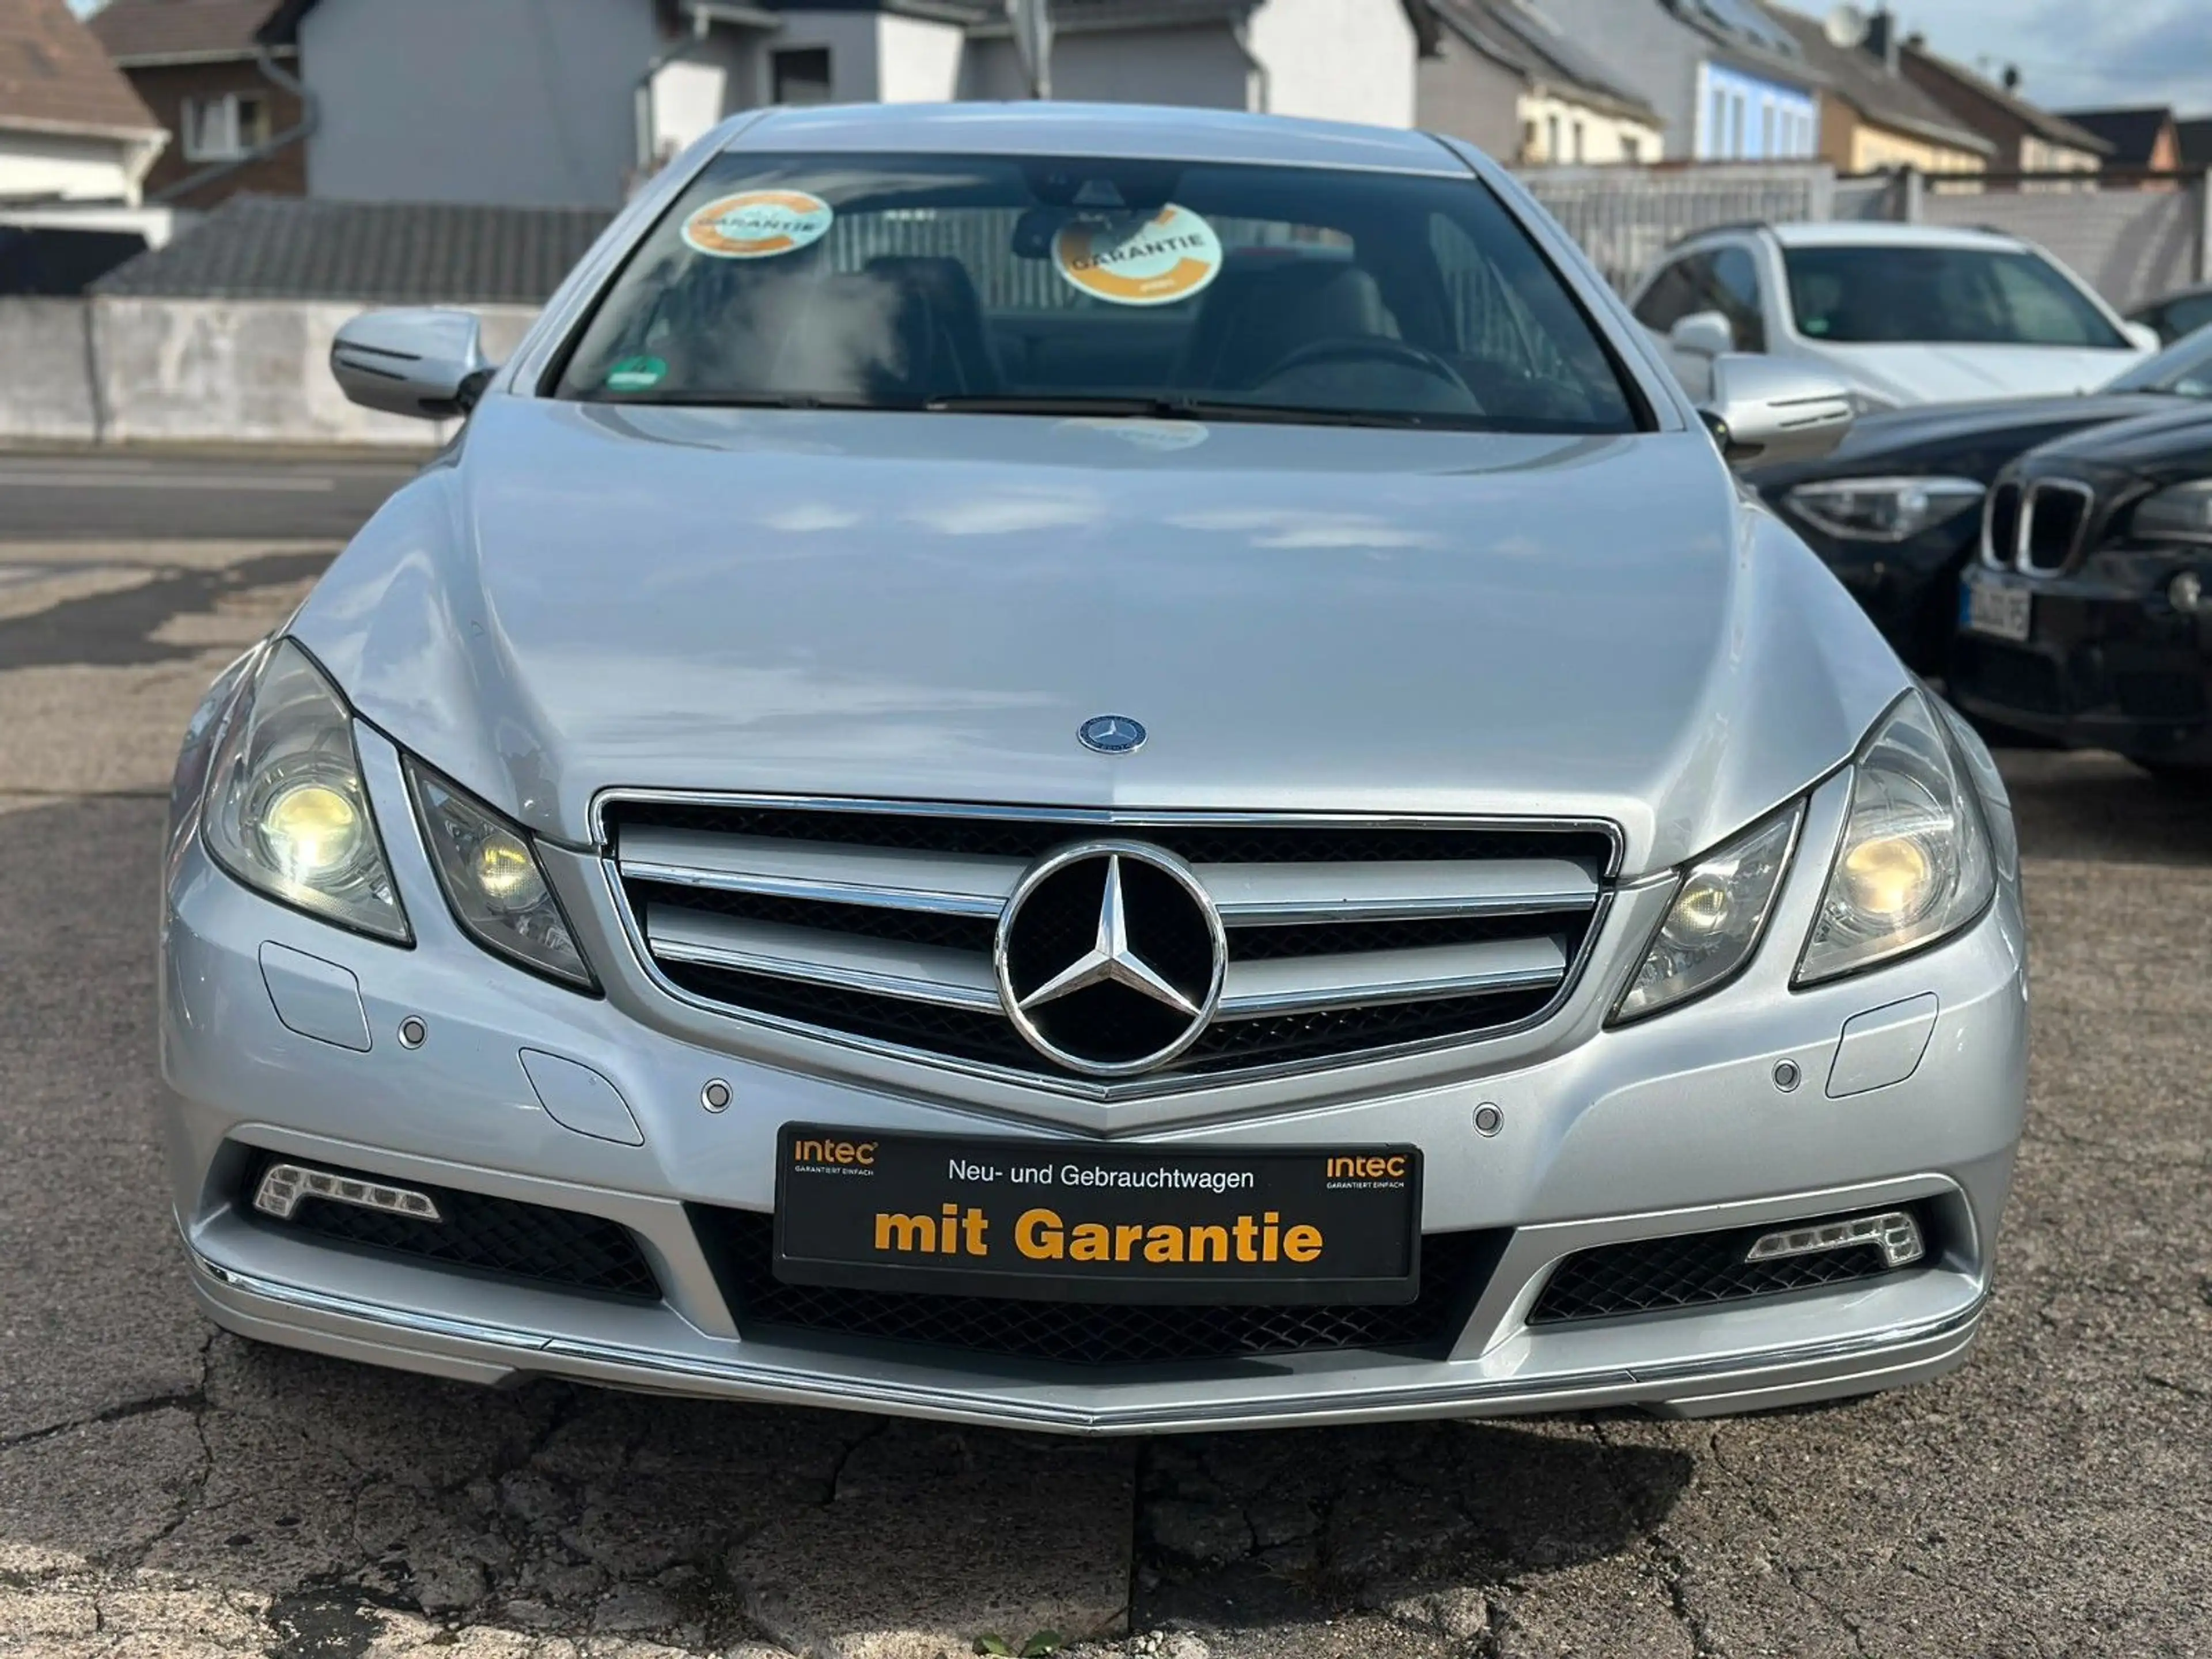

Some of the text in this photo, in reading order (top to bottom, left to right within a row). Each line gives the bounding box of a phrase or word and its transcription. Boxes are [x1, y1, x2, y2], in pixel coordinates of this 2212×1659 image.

[1072, 233, 1205, 270] GARANTIE
[795, 1139, 874, 1165] intec
[1327, 1155, 1406, 1177] intec
[949, 1159, 1253, 1194] Neu- und Gebrauchtwagen
[875, 1203, 1323, 1263] mit Garantie
